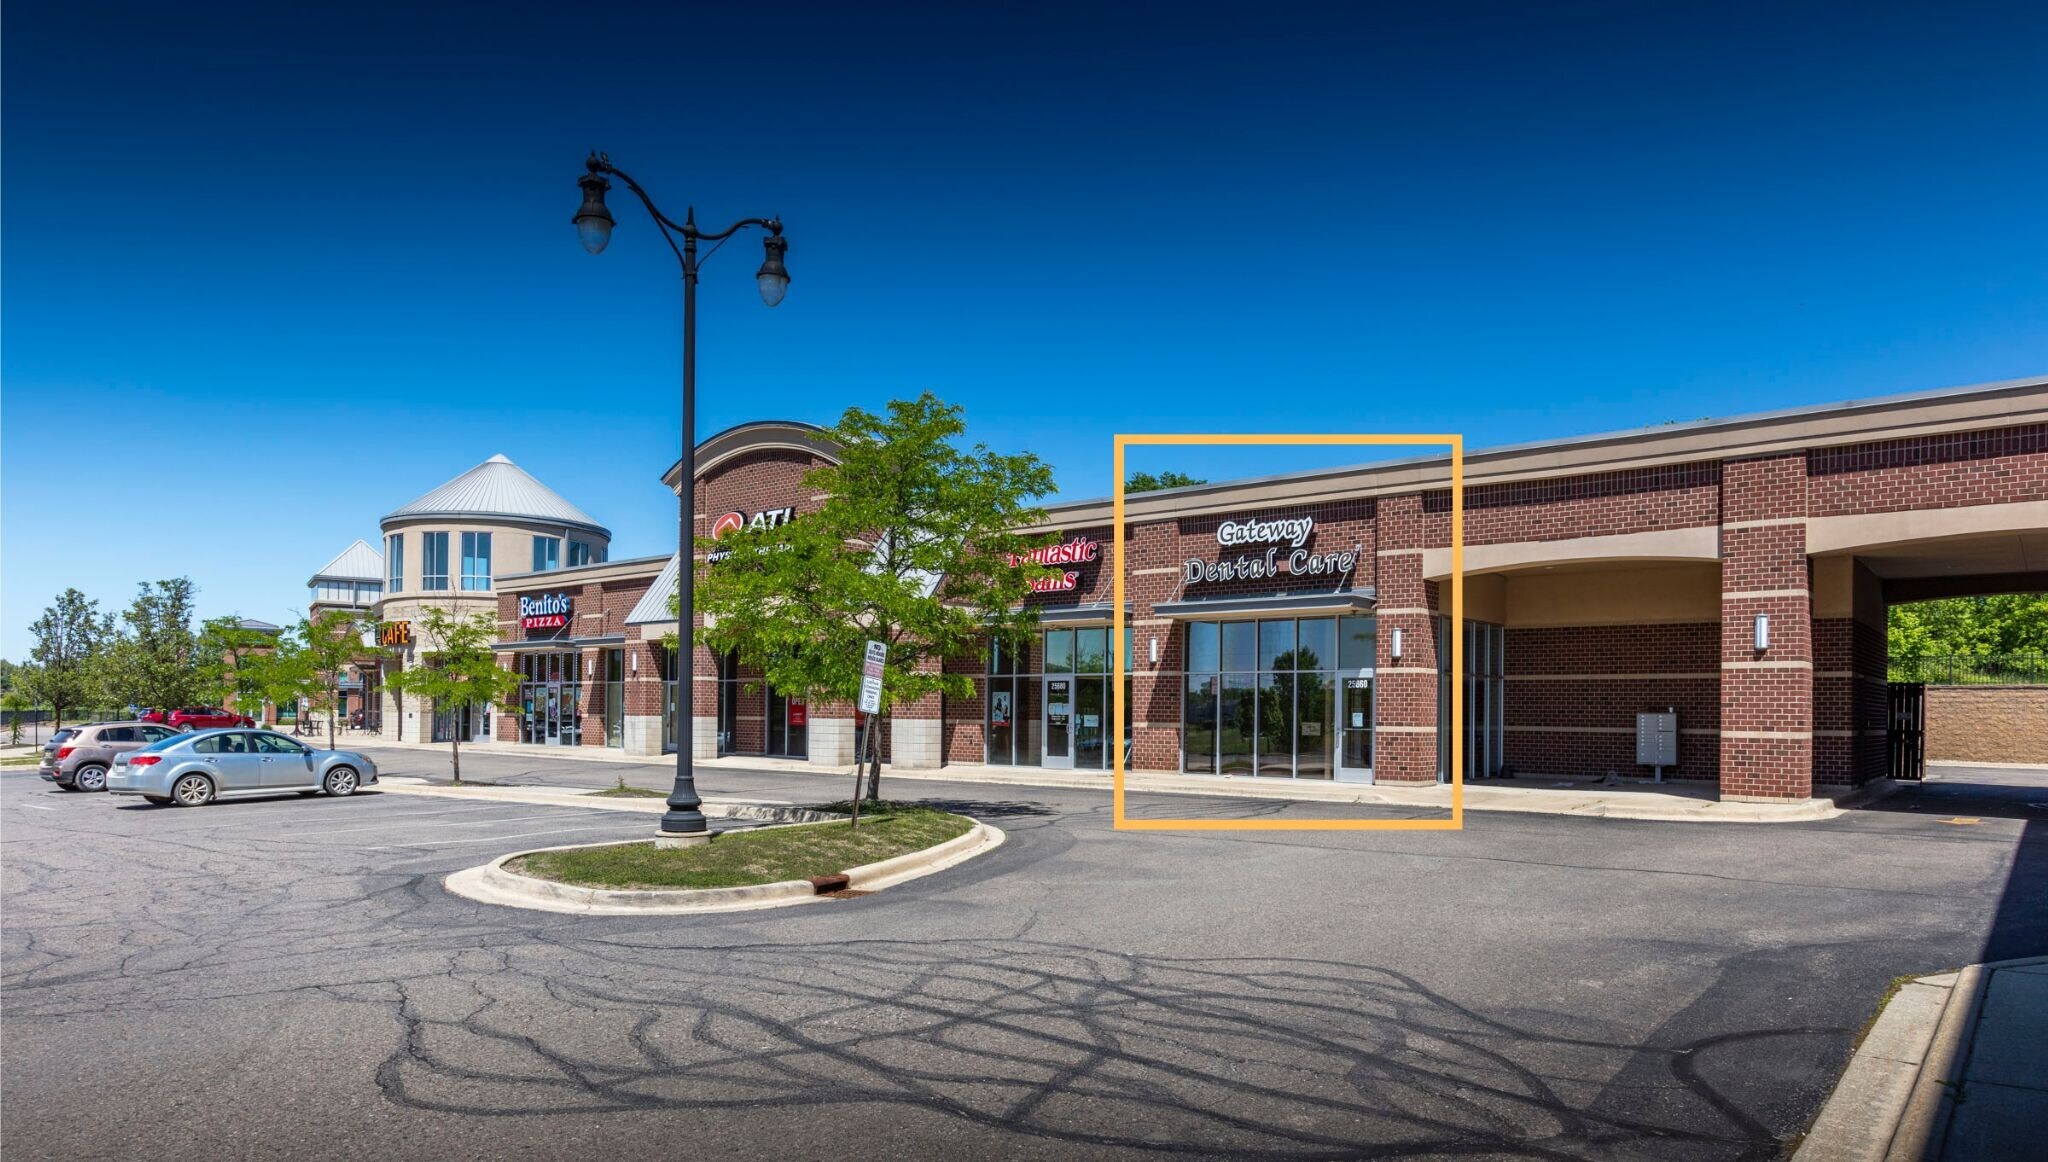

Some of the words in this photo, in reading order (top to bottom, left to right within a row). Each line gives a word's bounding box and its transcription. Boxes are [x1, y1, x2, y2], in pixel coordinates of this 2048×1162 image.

[746, 508, 792, 534] ATI
[1217, 516, 1313, 548] Gateway
[1184, 547, 1278, 584] Dental
[1289, 548, 1354, 576] Care
[520, 592, 568, 616] Benito's
[381, 621, 409, 645] CAFE
[525, 616, 562, 628] PIZZA
